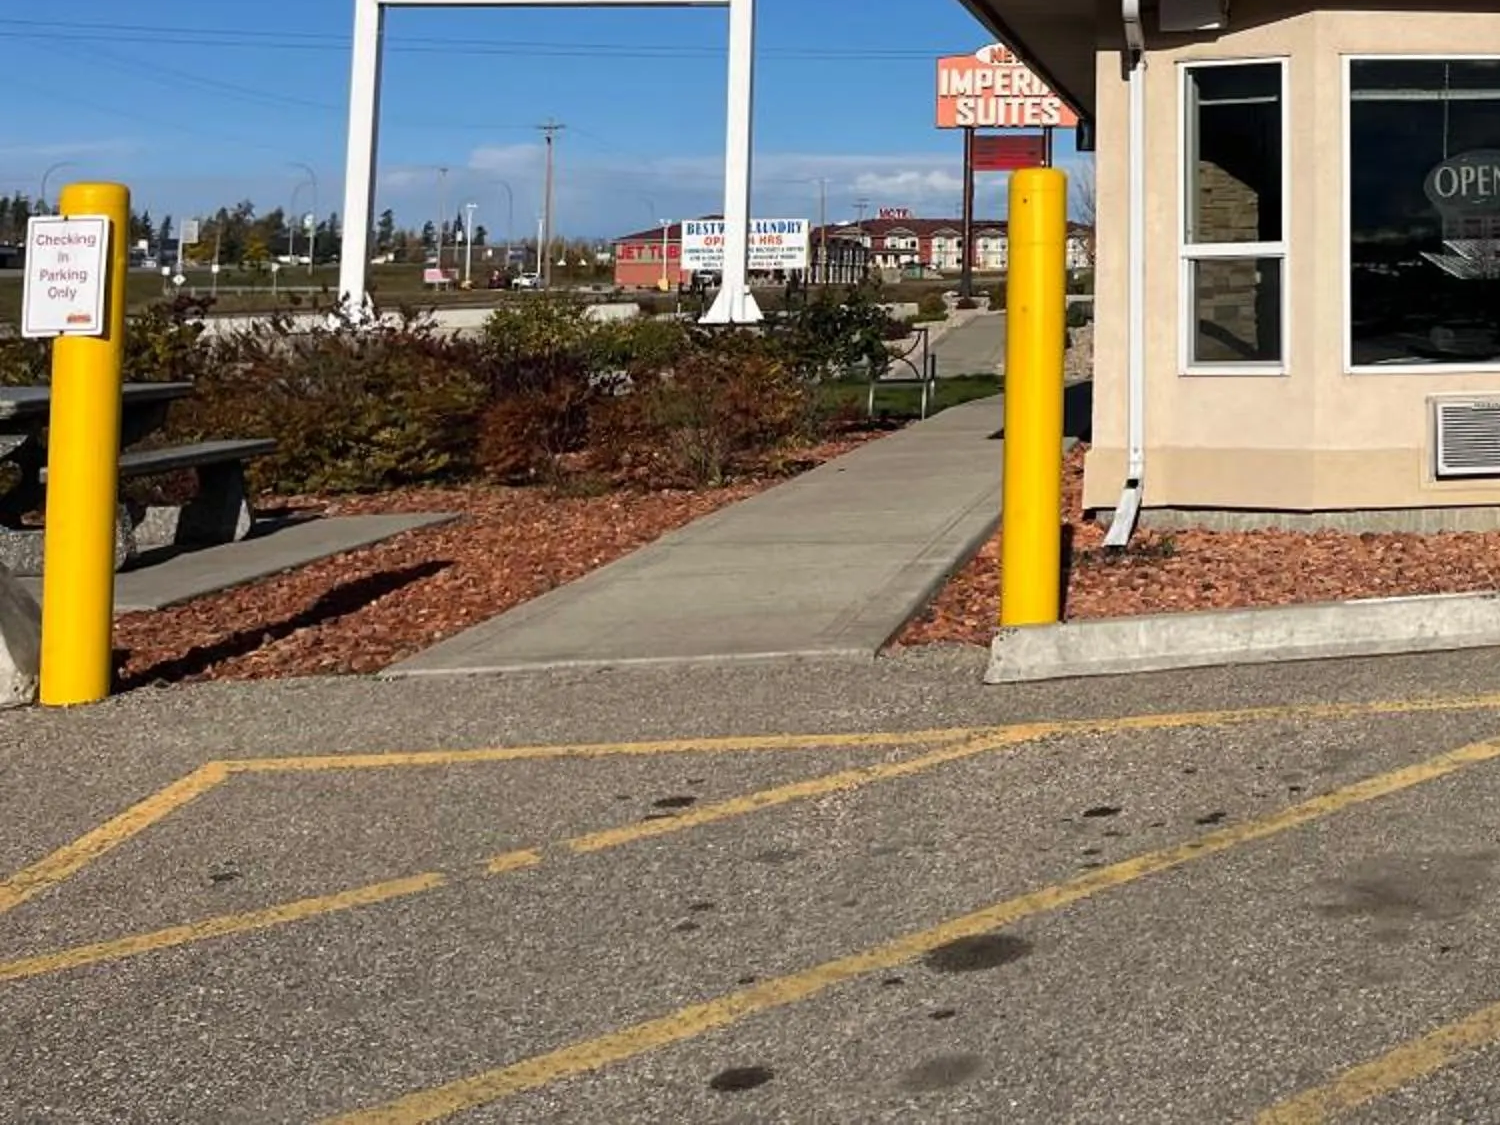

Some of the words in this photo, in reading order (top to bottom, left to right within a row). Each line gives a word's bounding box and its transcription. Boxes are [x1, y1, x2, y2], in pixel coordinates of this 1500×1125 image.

[990, 46, 1021, 64] NE
[939, 68, 1051, 96] IMPERI
[955, 96, 1061, 126] SUITES
[36, 233, 96, 247] Checking
[759, 235, 783, 245] HRS
[40, 268, 88, 283] Parking
[47, 286, 76, 301] Only
